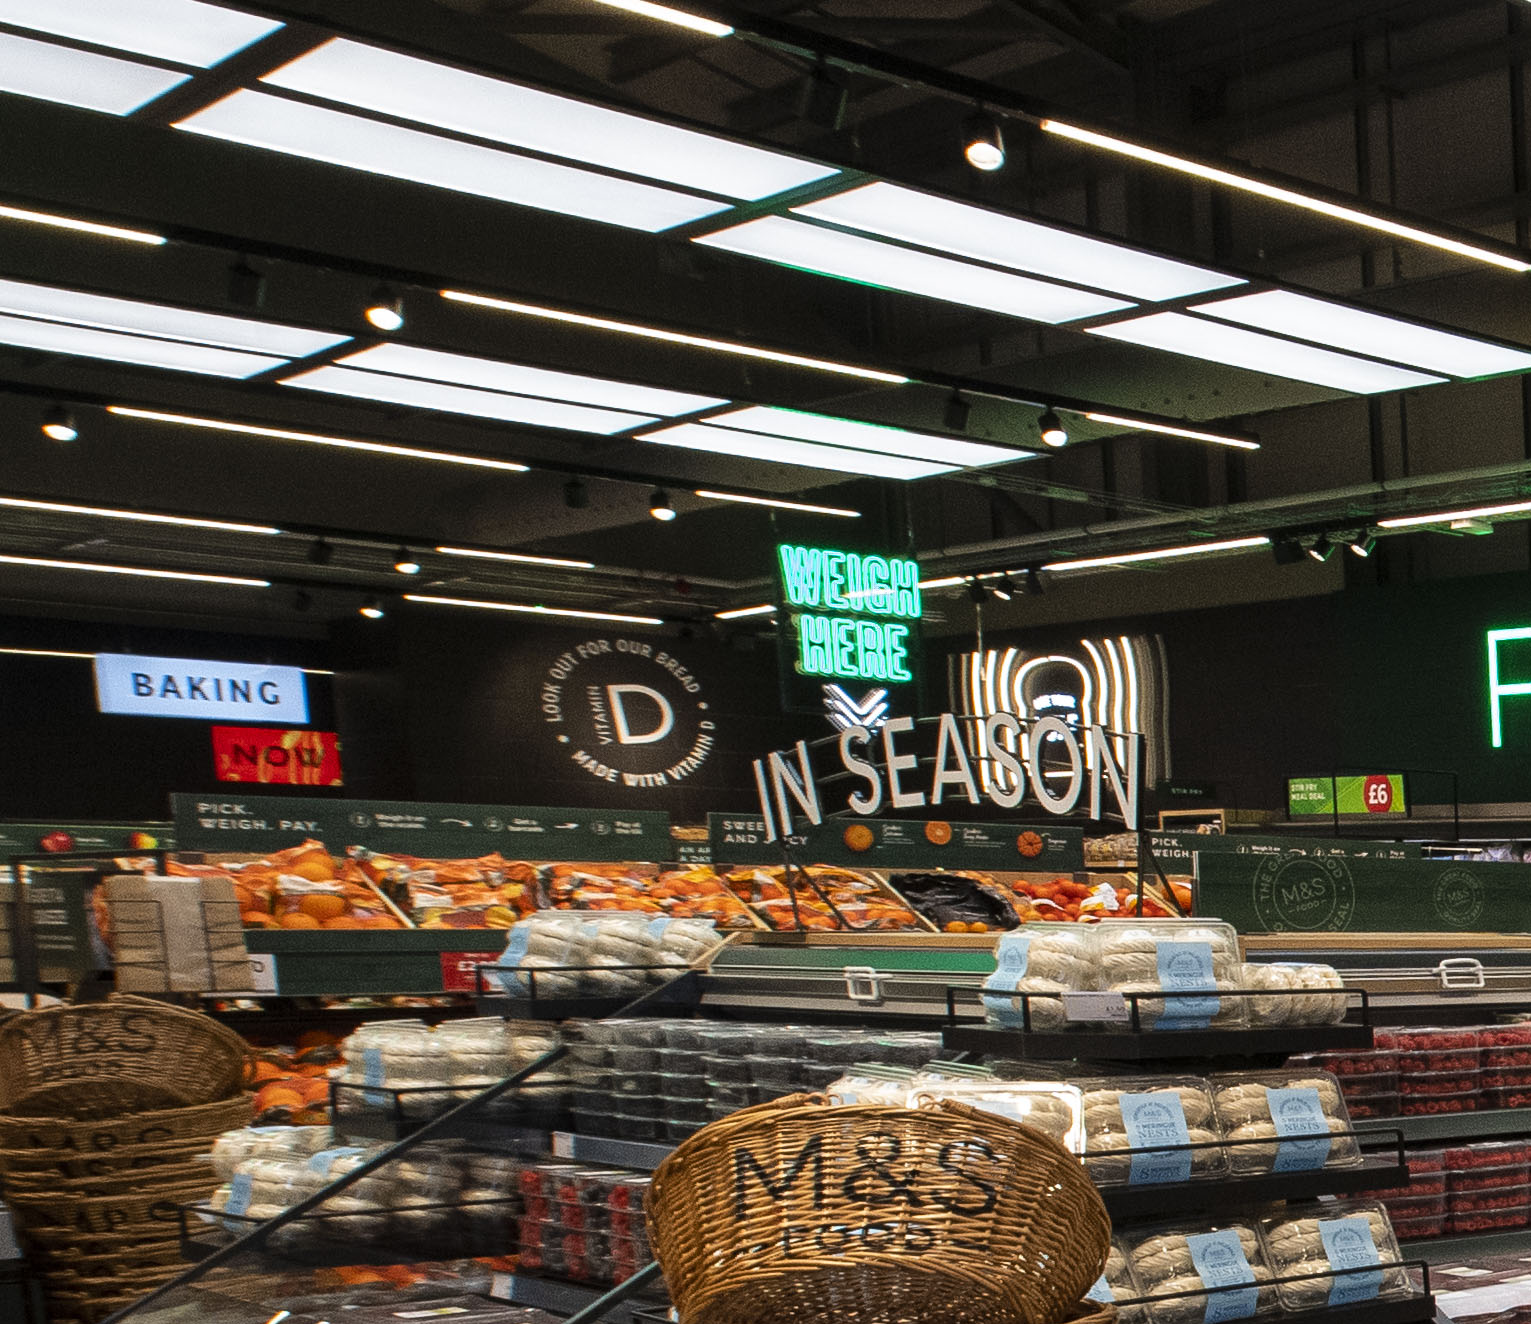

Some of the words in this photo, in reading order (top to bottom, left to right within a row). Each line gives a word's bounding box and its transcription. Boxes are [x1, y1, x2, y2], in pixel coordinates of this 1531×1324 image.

[778, 544, 921, 618] WEIGH
[576, 639, 613, 658] FOR
[616, 639, 652, 658] OUR
[800, 613, 912, 681] HERE
[550, 652, 579, 680] OUT
[656, 652, 700, 693] BREAD
[131, 672, 281, 705] BAKING
[541, 682, 562, 722] LOOK
[586, 685, 613, 745] VITAMIN
[606, 684, 674, 744] D
[232, 744, 323, 768] NOW
[571, 750, 619, 783] MADE
[622, 772, 668, 787] WITH
[666, 734, 714, 780] VITAMIN
[700, 721, 715, 730] D
[753, 740, 825, 842] IN
[838, 712, 1138, 830] SEASON
[1368, 784, 1388, 805] £6
[198, 802, 253, 815] PICK.
[199, 817, 274, 830] WEIGH.
[279, 819, 323, 832] PAY.
[723, 821, 768, 831] SWEE
[723, 834, 757, 844] AND
[1152, 838, 1182, 847] PICK.
[1282, 878, 1326, 905] M&S
[1138, 1128, 1179, 1139] NESTS
[735, 1130, 999, 1219] M&S
